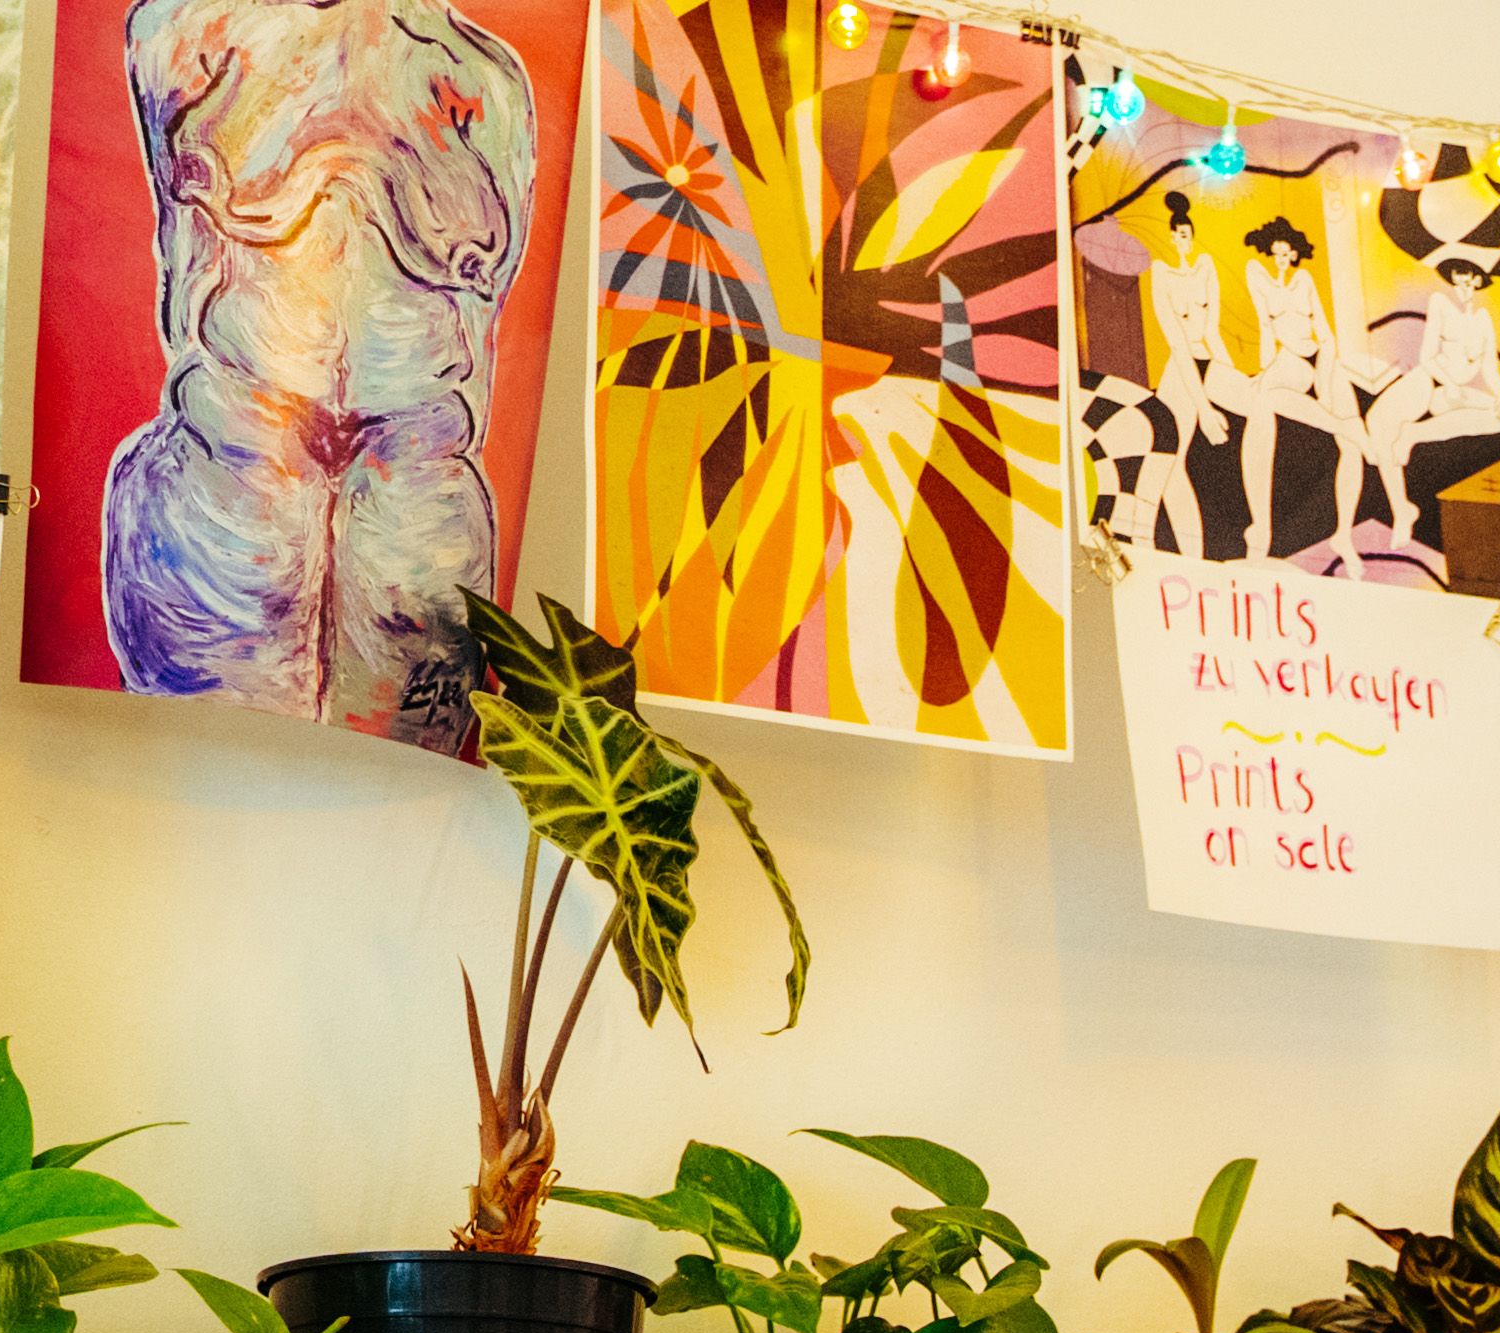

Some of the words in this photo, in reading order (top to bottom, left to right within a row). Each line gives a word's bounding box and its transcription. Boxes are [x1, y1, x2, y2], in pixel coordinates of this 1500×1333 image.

[1159, 573, 1317, 647] Prints
[1190, 652, 1237, 692] zu
[1254, 652, 1448, 732] verkaufen
[1174, 744, 1315, 815] Prints
[1204, 826, 1251, 867] on
[1276, 823, 1355, 873] sale
